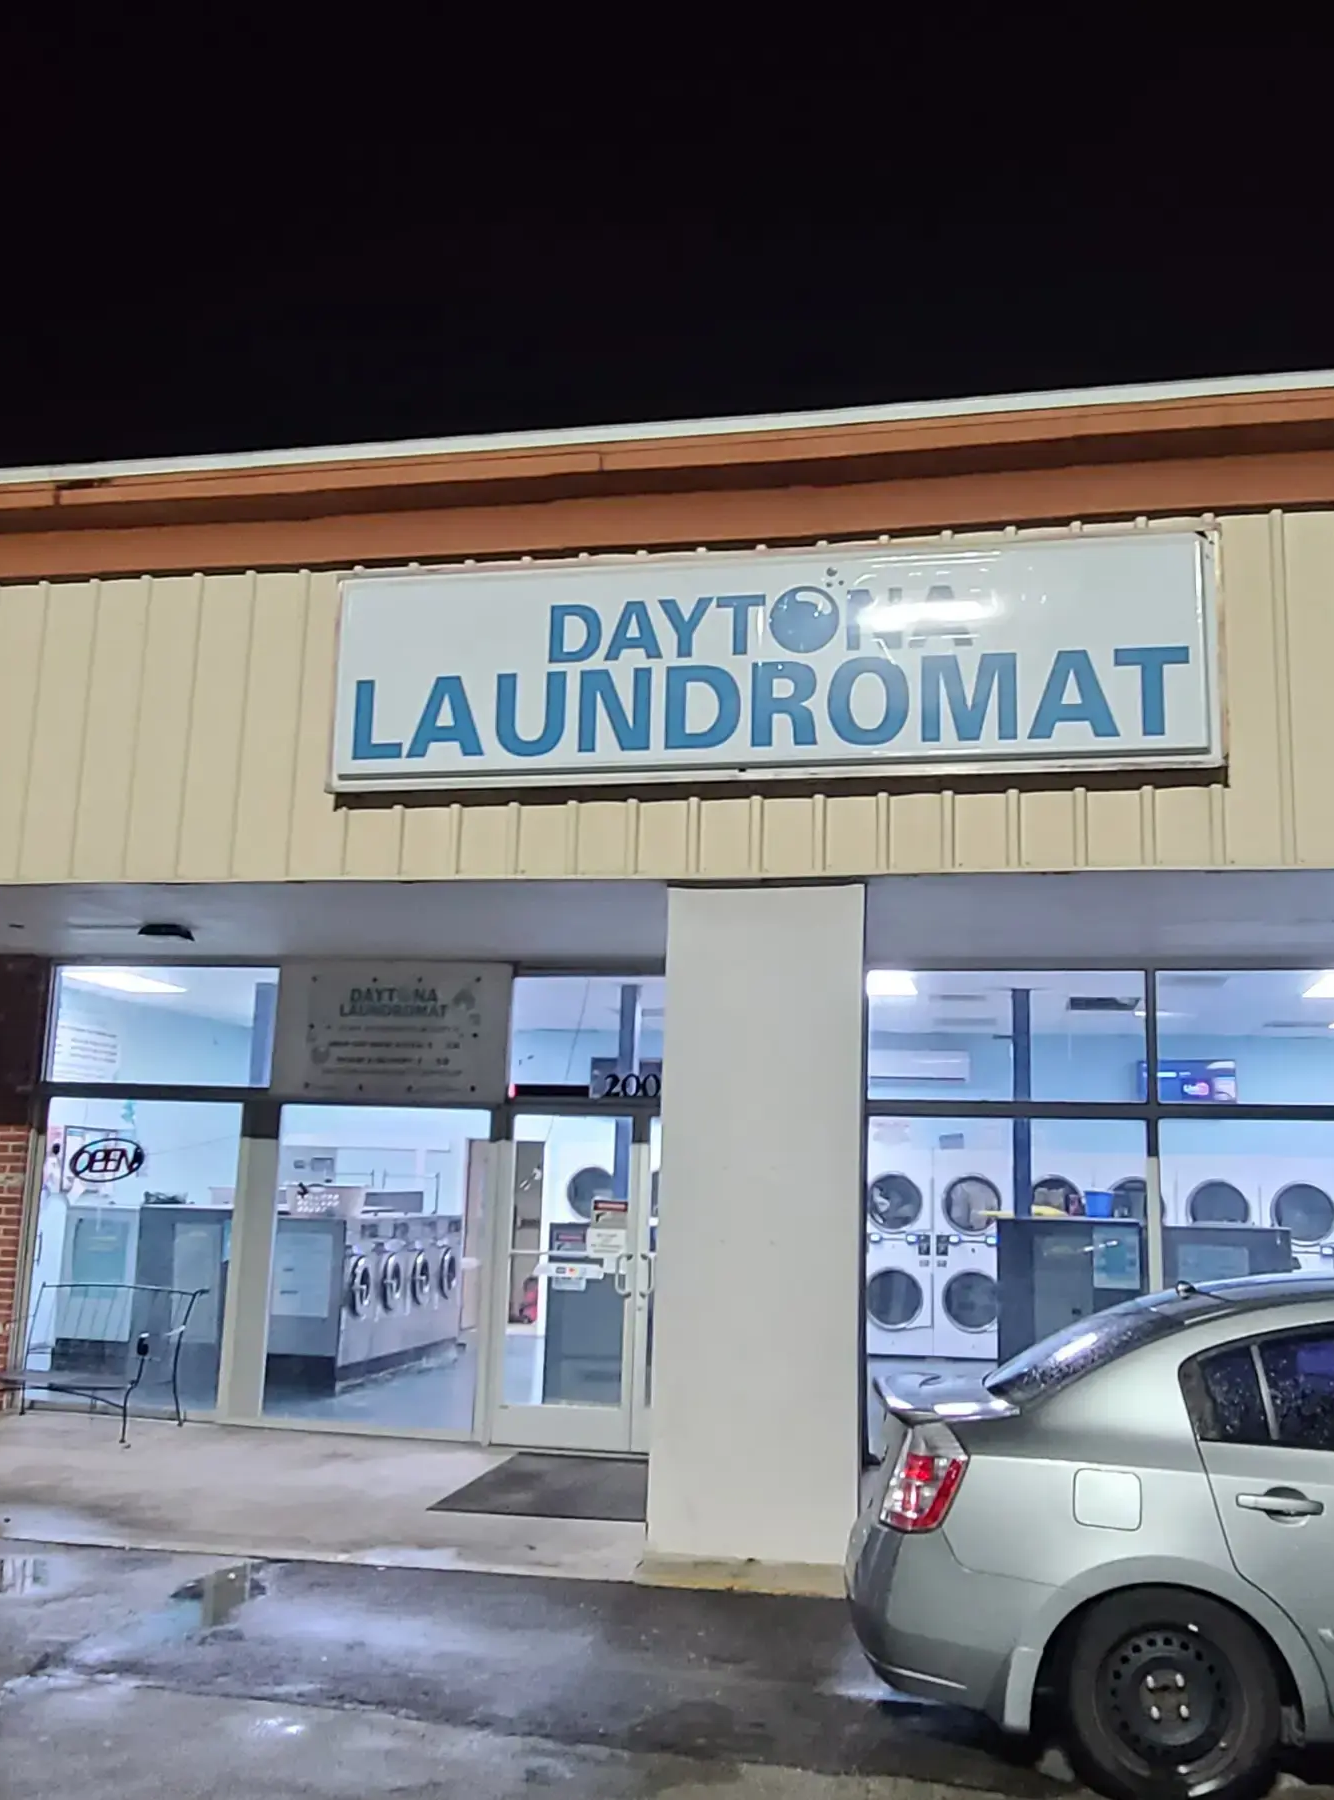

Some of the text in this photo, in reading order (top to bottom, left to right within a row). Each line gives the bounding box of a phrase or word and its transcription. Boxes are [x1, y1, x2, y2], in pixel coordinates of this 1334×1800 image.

[548, 585, 973, 663] DAYTONA
[351, 646, 1190, 760] LAUNDROMAT
[350, 987, 439, 1003] DAYTONA
[603, 1073, 661, 1097] 200
[72, 1147, 141, 1175] OPEN
